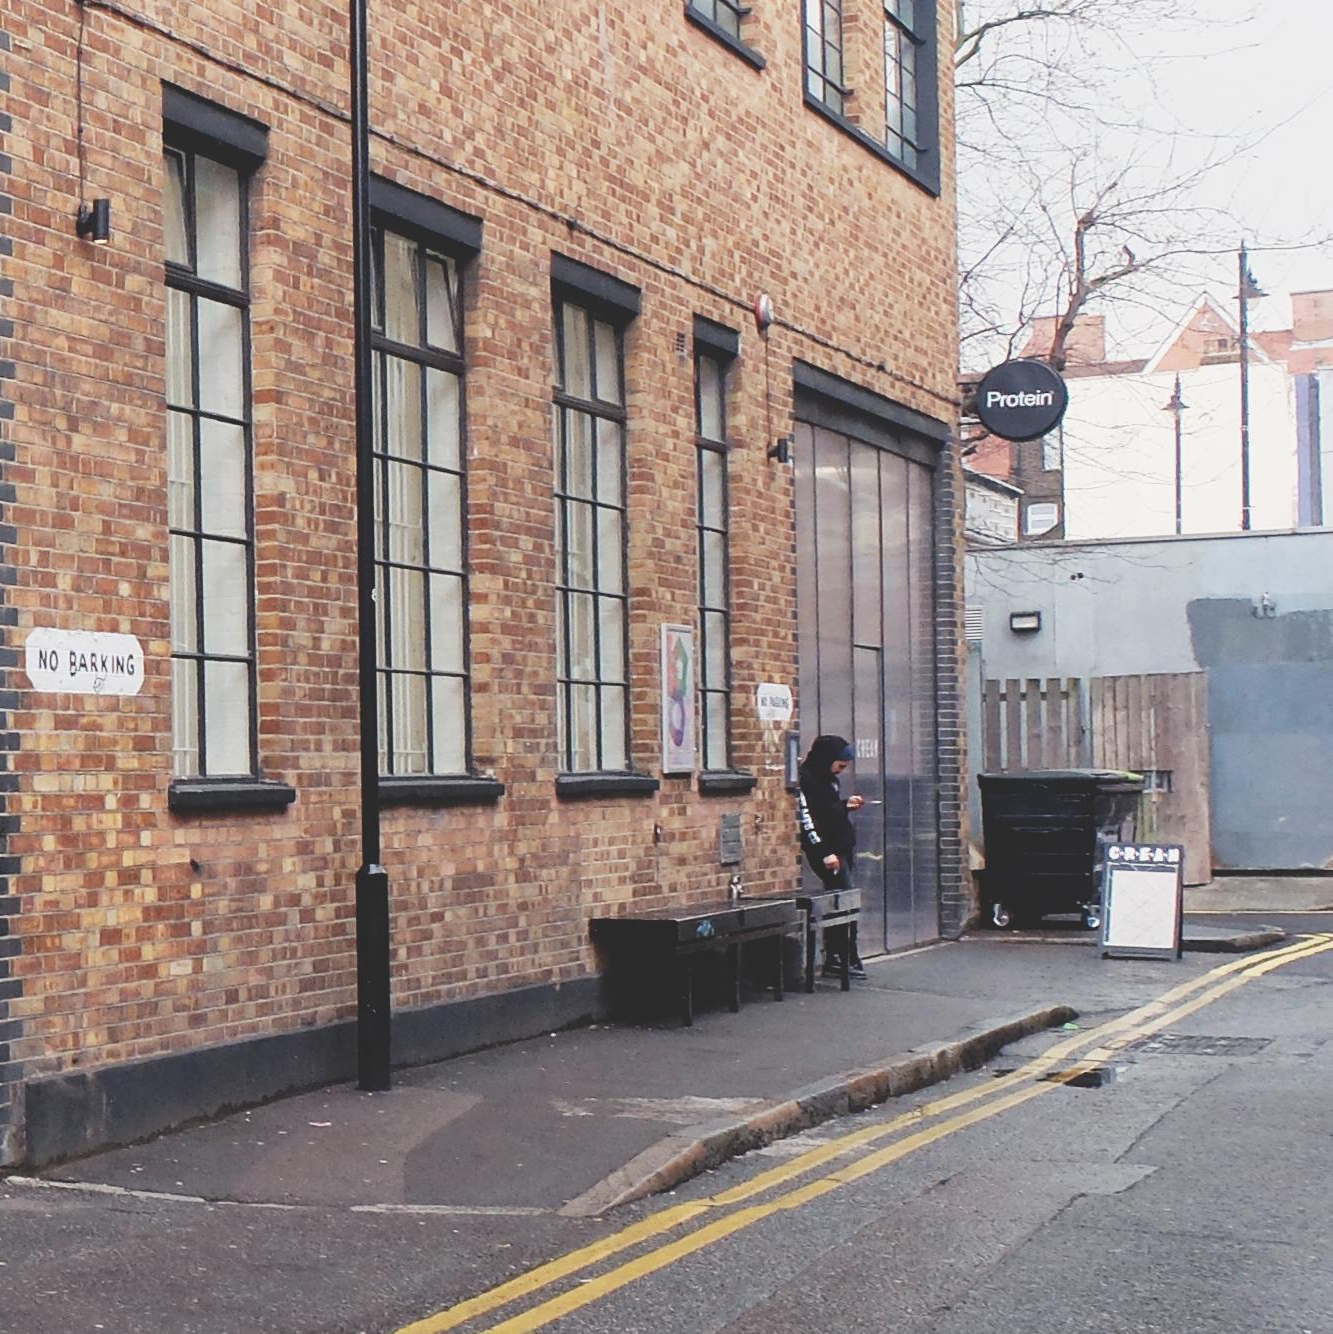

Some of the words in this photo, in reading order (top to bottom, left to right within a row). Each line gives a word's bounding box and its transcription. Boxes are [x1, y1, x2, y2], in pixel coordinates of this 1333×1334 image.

[986, 389, 1052, 408] Protein
[38, 649, 59, 672] NO
[69, 650, 135, 677] BARKING
